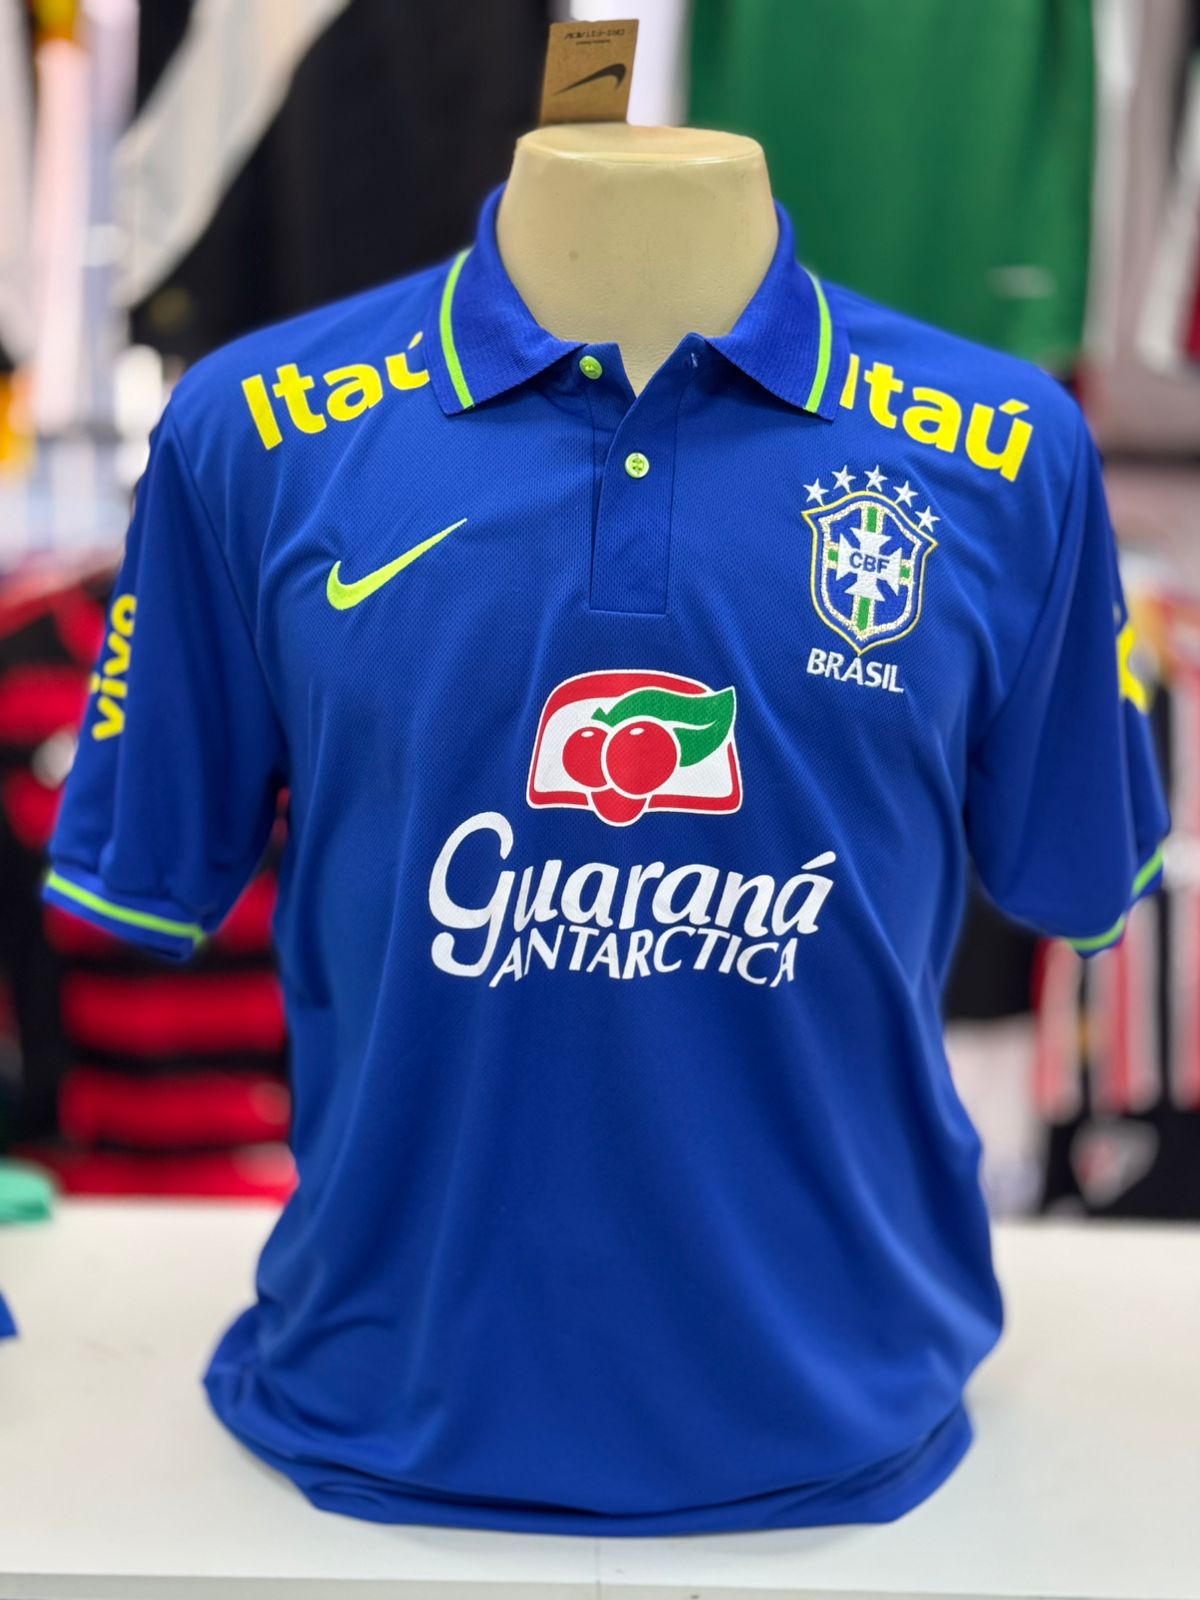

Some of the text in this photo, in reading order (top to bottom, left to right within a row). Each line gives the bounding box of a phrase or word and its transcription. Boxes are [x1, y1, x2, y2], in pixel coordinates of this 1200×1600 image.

[839, 353, 1033, 482] Itaú
[849, 551, 890, 574] CBF
[806, 648, 904, 693] BRASIL
[428, 811, 837, 978] Guaraná
[488, 924, 798, 989] ANTARCTICA
